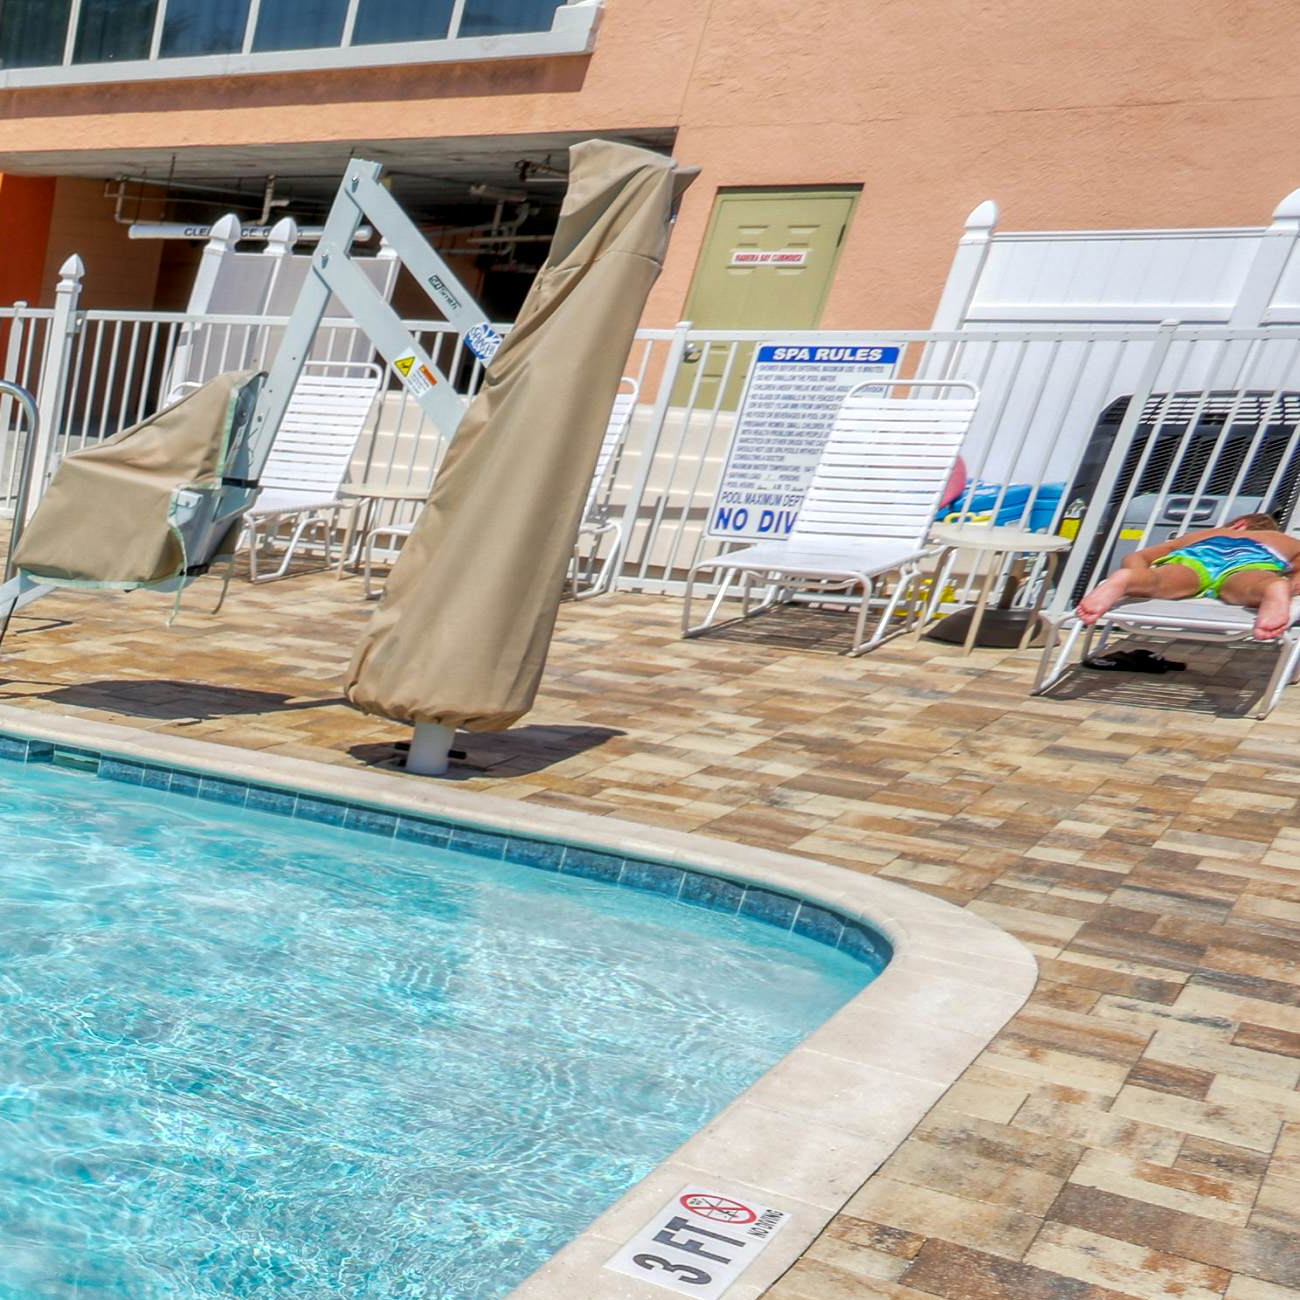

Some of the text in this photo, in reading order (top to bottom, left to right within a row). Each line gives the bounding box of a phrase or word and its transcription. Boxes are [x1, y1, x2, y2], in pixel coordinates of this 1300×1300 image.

[772, 347, 883, 362] SPA RULES
[721, 491, 805, 507] POOL MAXIMUM DEPT
[714, 507, 799, 534] NO DIV
[632, 1215, 746, 1285] 3 FT
